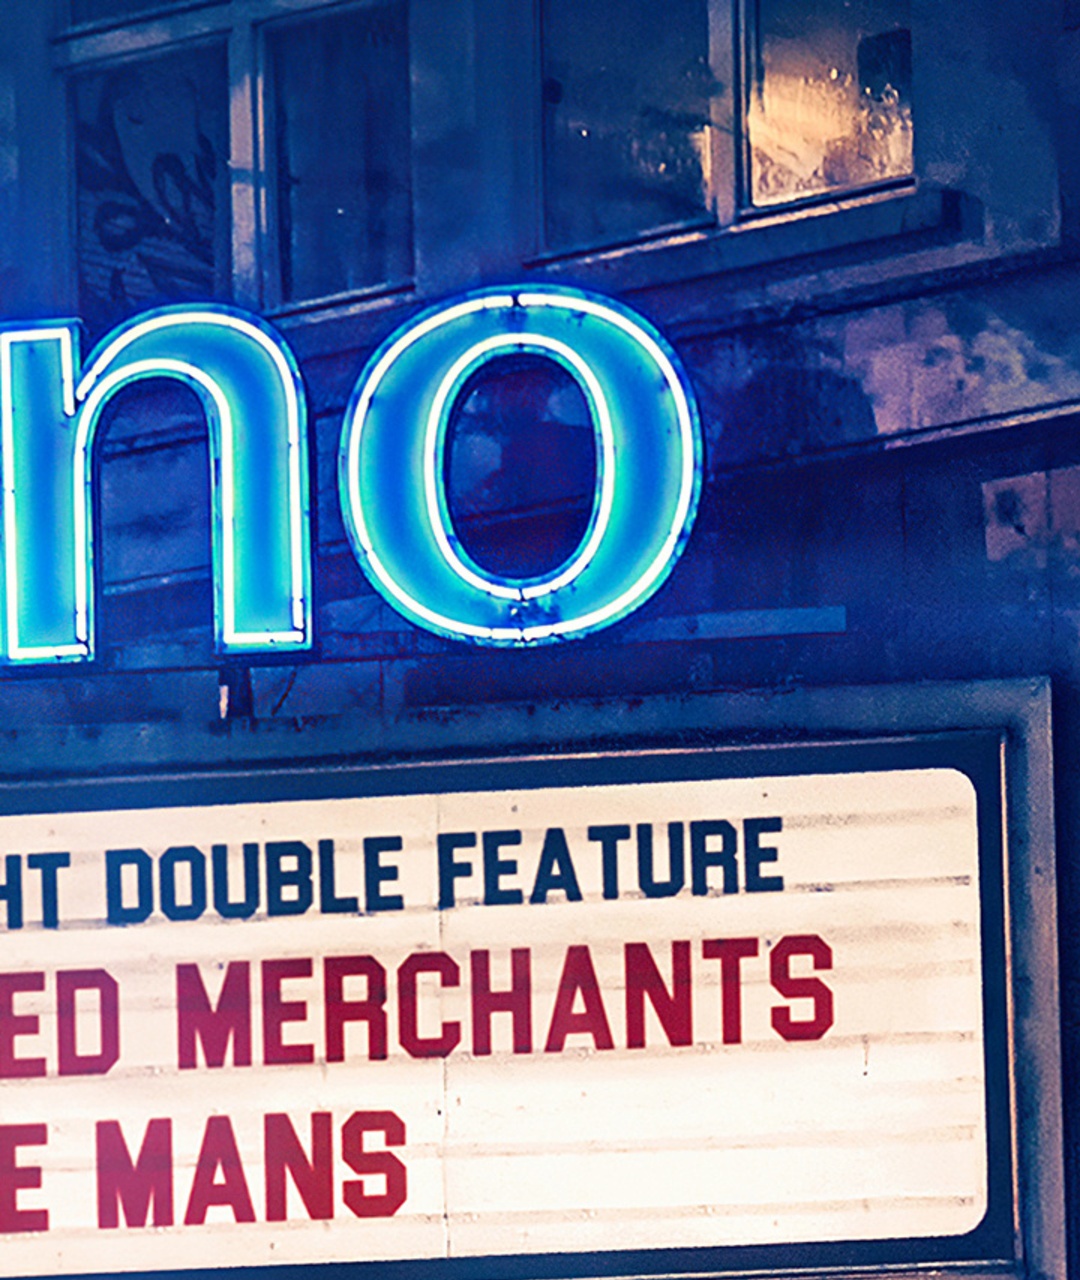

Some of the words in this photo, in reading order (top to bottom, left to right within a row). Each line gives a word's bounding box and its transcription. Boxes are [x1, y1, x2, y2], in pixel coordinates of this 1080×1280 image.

[0, 284, 705, 662] no
[105, 836, 404, 926] DOUBLE
[438, 816, 784, 910] FEATURE
[0, 968, 119, 1079] ED
[176, 934, 834, 1070] MERCHANTS
[0, 1123, 49, 1233] E
[96, 1110, 408, 1230] MANS
